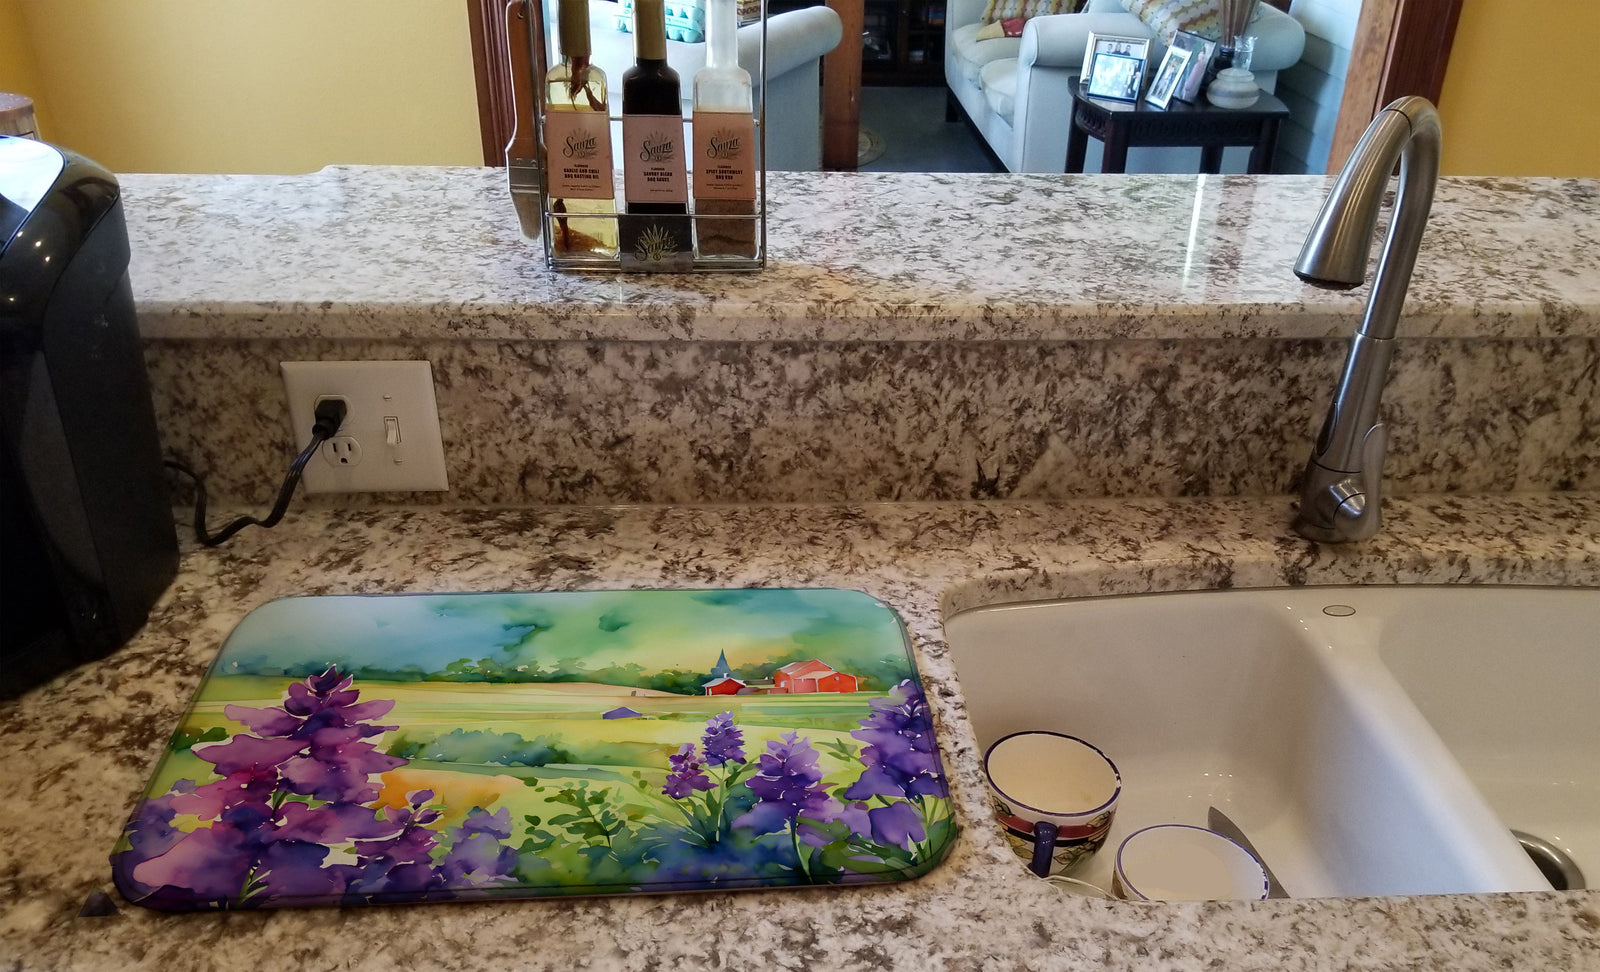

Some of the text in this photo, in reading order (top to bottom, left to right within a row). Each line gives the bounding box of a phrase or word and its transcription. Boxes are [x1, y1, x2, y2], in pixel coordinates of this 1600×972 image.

[563, 135, 597, 158] Sauza
[640, 139, 673, 162] Sauza
[707, 136, 740, 159] Sauza
